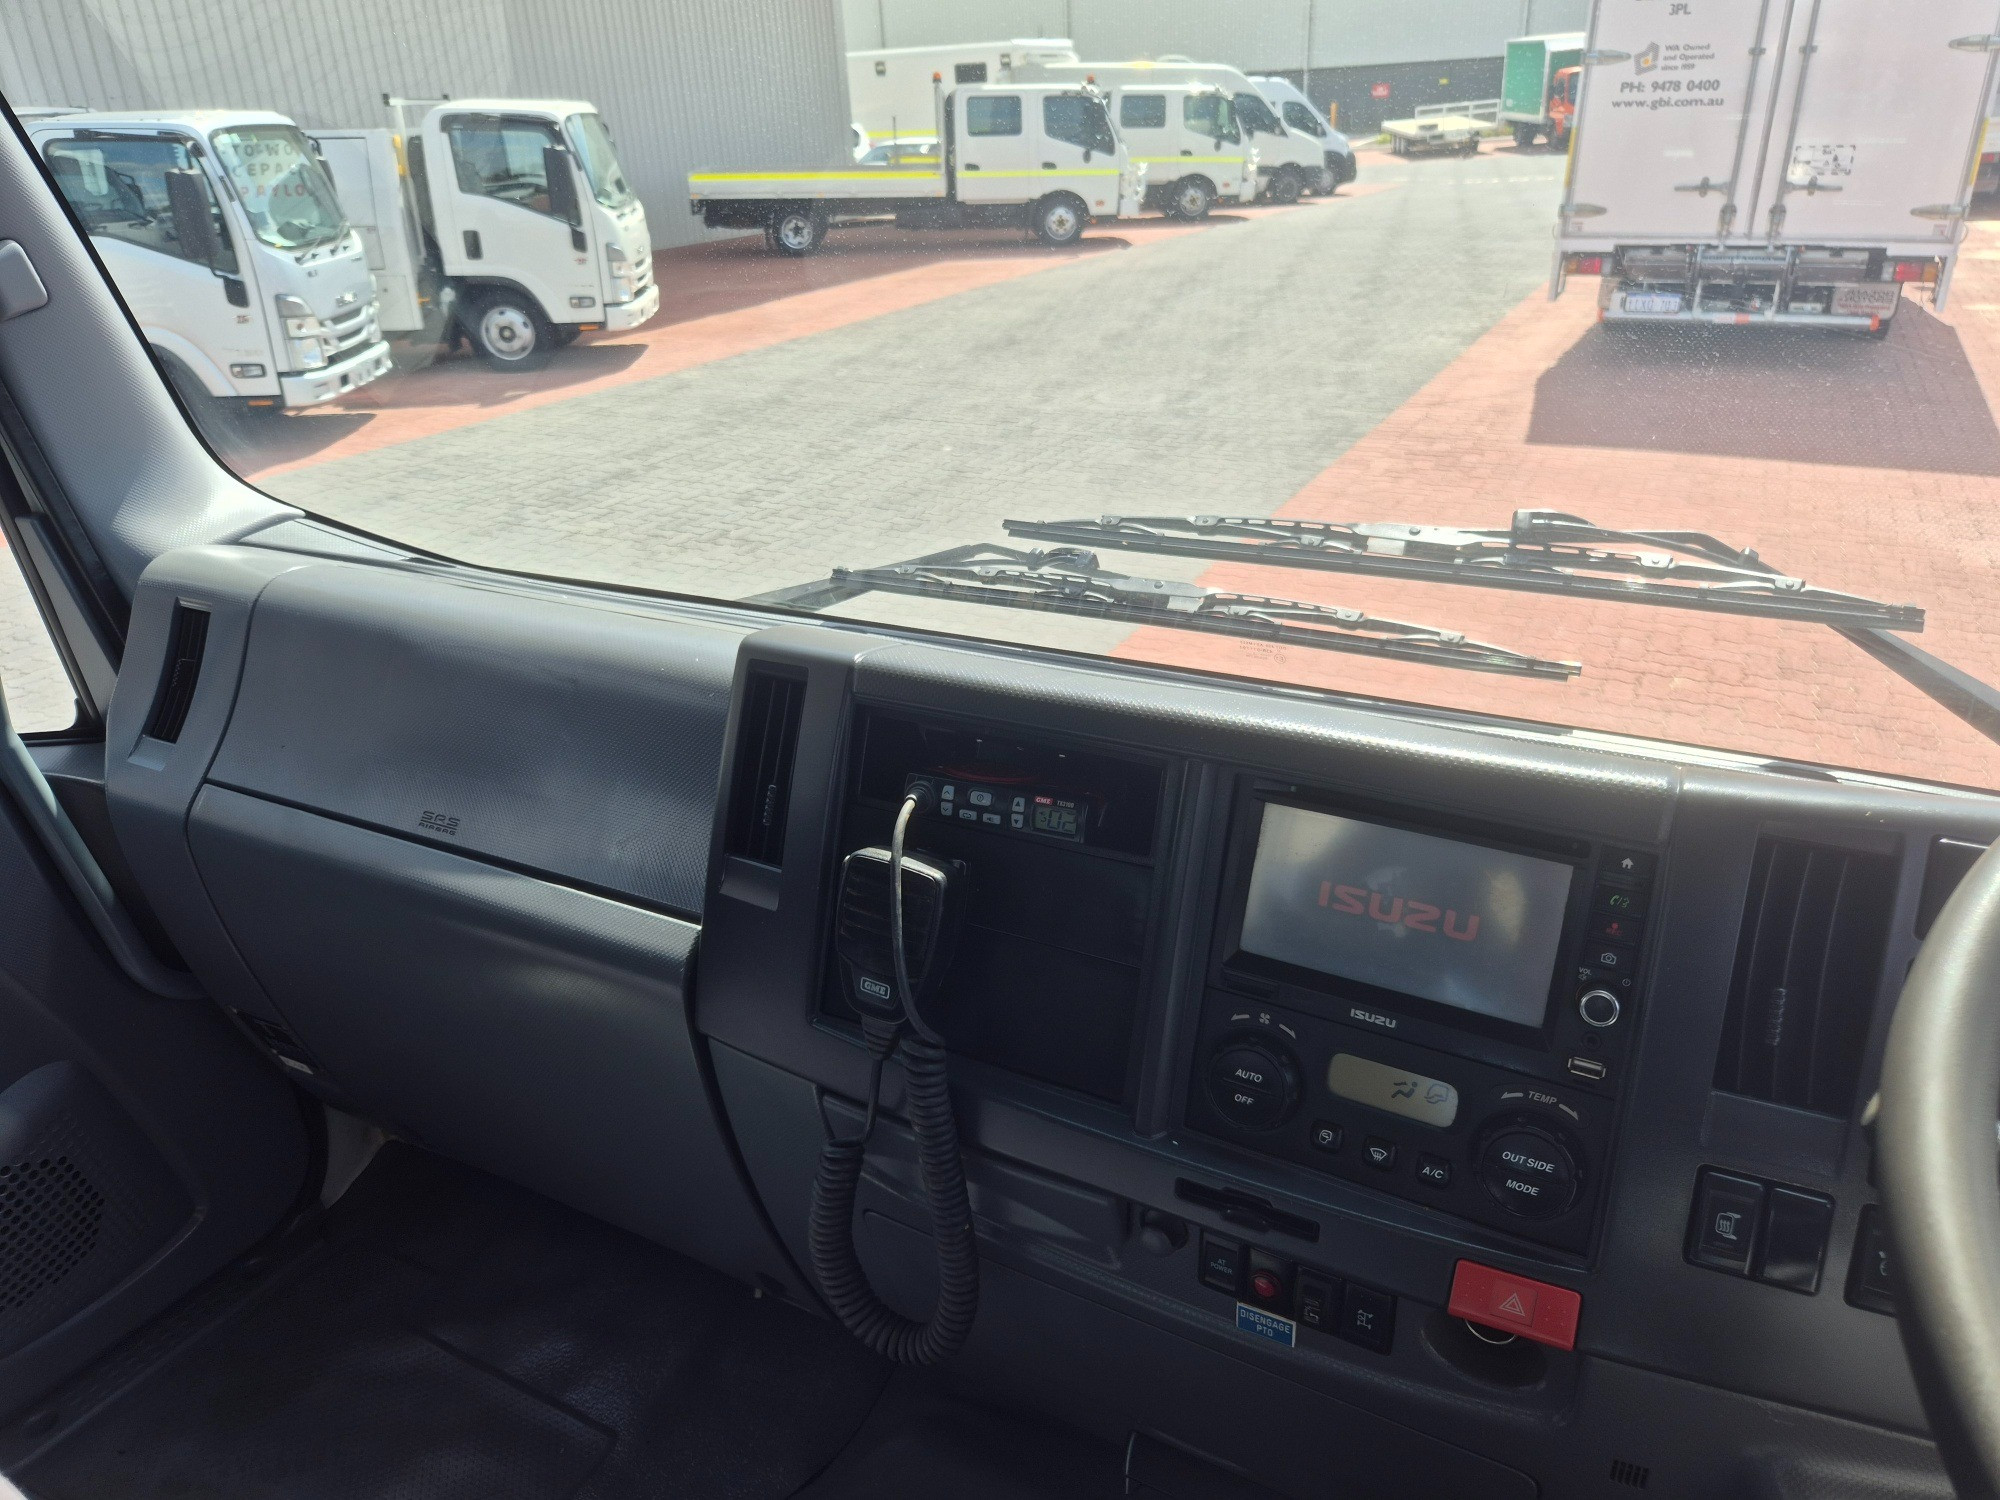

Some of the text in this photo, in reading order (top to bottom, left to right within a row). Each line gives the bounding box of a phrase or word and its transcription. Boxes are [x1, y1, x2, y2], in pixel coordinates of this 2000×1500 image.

[1668, 3, 1691, 16] 3PL
[1682, 43, 1711, 51] Owned
[1679, 53, 1715, 61] Operated
[1619, 79, 1721, 93] PH: 9478 0400
[1611, 96, 1725, 110] www.gbi.com.au
[1035, 797, 1051, 805] GME
[421, 811, 460, 827] SRS
[418, 821, 457, 836] AIRBAG
[1317, 880, 1480, 942] ISUZU
[1578, 966, 1592, 976] VOL
[864, 981, 886, 995] GME
[1350, 1008, 1397, 1029] ISUZU
[1235, 1068, 1263, 1083] AUTO
[1234, 1093, 1255, 1106] OFF
[1528, 1090, 1557, 1104] TEMP
[1502, 1151, 1556, 1174] OUT SIDE
[1422, 1166, 1444, 1179] A/C
[1505, 1179, 1540, 1197] MODE
[1210, 1261, 1234, 1275] POWER
[1217, 1258, 1227, 1266] AT
[1240, 1309, 1291, 1334] DISENGAGE
[1256, 1324, 1273, 1337] PTO
